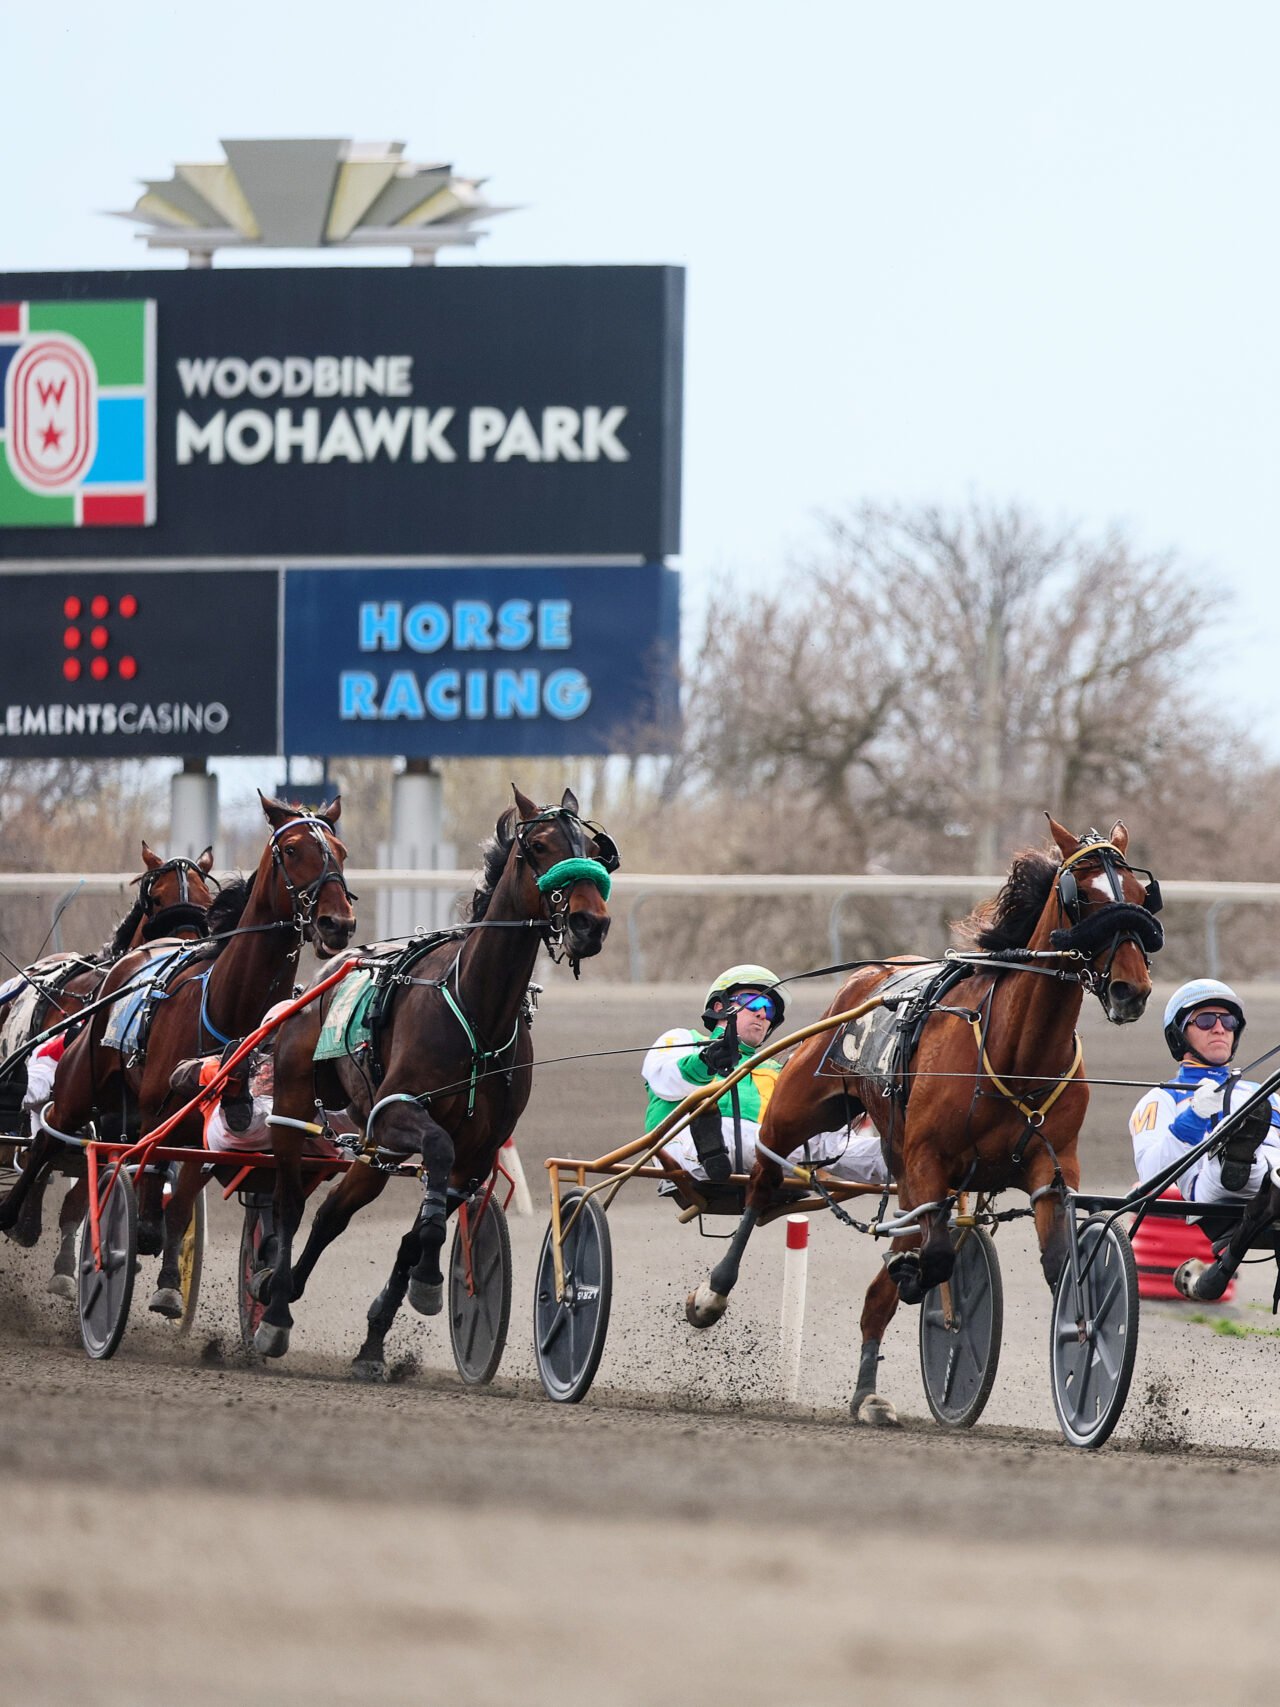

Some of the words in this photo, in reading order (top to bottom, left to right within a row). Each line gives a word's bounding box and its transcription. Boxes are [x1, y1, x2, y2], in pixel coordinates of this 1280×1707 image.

[36, 377, 67, 407] W
[177, 356, 412, 399] WOODBINE
[175, 407, 456, 464] MOHAWK
[468, 405, 629, 462] PARK
[359, 600, 571, 652] HORSE
[340, 669, 591, 719] RACING
